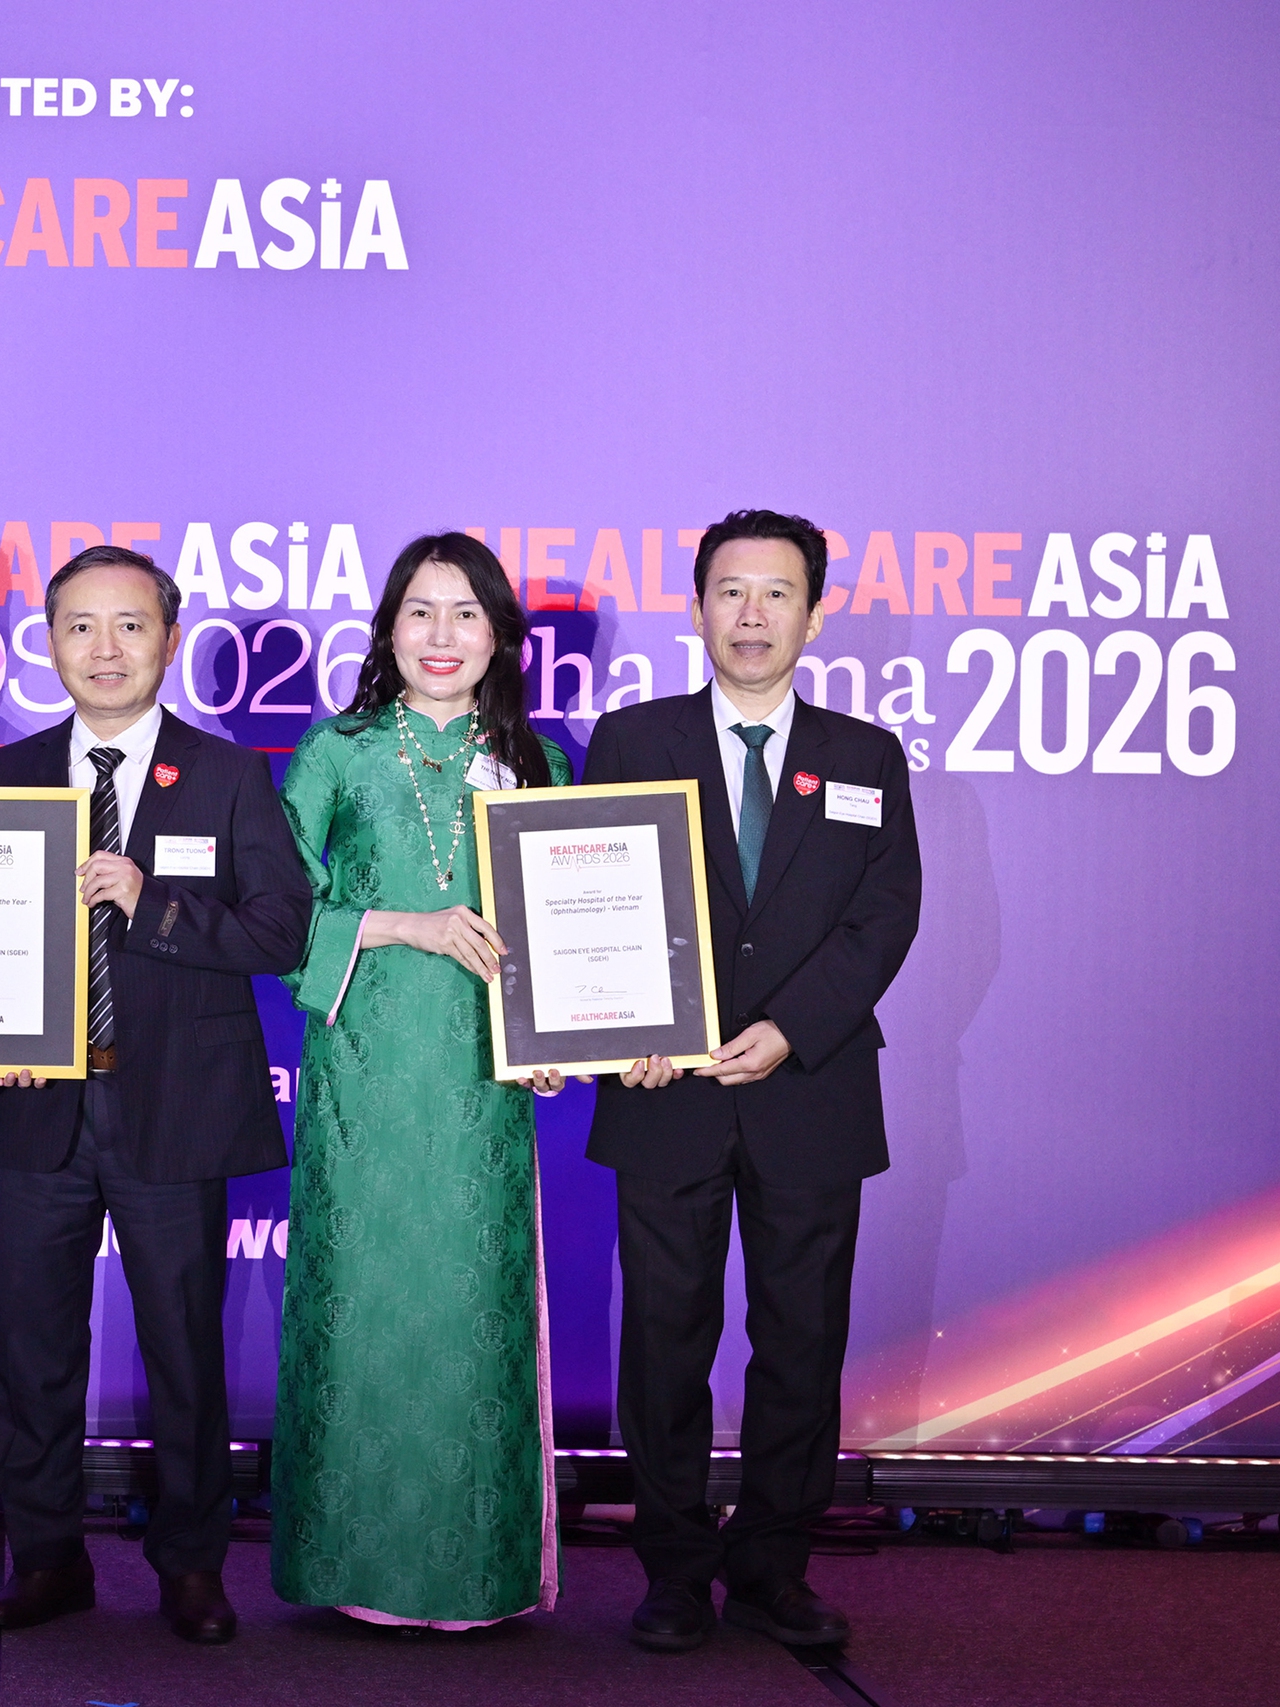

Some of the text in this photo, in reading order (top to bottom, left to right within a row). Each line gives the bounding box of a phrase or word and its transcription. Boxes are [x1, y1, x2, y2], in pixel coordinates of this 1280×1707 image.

[109, 78, 194, 118] BY:
[169, 617, 373, 715] 026
[945, 628, 1237, 777] 2026
[836, 794, 870, 804] HONG CHAU
[602, 852, 631, 864] 2026
[545, 898, 577, 907] Specialty
[577, 896, 605, 905] Hospital
[550, 905, 606, 915] (Ophthalmology)
[611, 904, 640, 912] Vietnam
[553, 948, 577, 956] SAIGON
[590, 946, 621, 954] HOSPITAL
[622, 944, 642, 952] CHAIN
